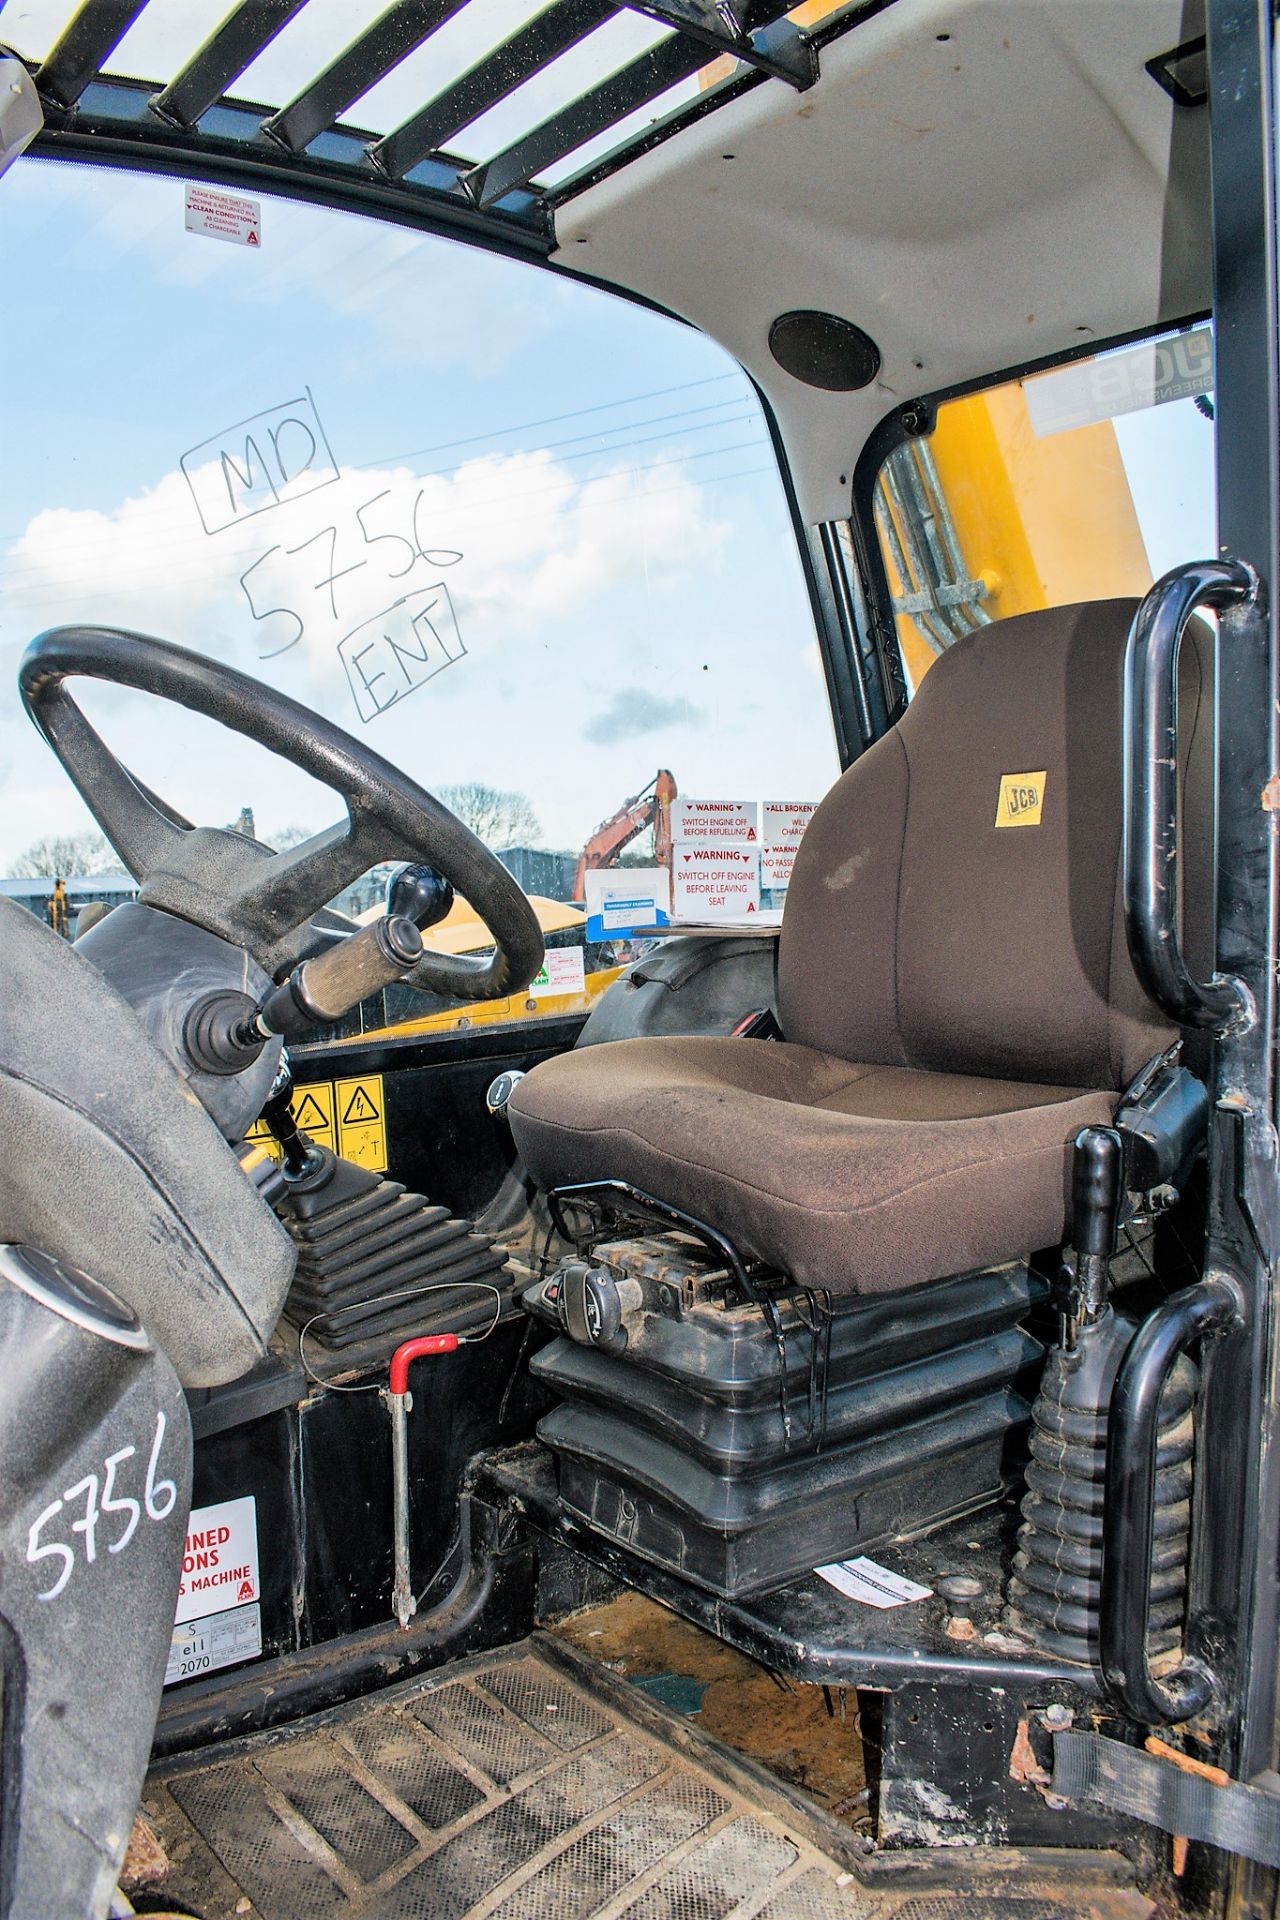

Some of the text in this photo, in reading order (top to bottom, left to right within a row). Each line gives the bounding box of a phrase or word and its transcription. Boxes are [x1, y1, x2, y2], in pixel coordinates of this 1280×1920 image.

[209, 194, 228, 203] ENSURE
[189, 197, 213, 206] MACHINE
[219, 204, 244, 214] RETURNED
[193, 204, 252, 223] CLEAN CONDITION
[213, 217, 239, 228] CLEANING
[209, 223, 241, 236] CHARGEABLE
[221, 418, 316, 513] MD
[240, 489, 464, 660] 5756
[1009, 787, 1036, 813] JCB
[695, 804, 734, 812] WARNING
[770, 804, 784, 812] ALL
[681, 818, 747, 826] SWITCH ENGINE OFF
[683, 828, 746, 836] BEFORE REFUELLING
[781, 828, 804, 836] CHARG
[693, 850, 741, 860] WARNING
[762, 859, 774, 867] NO
[677, 871, 755, 880] SWITCH OFF ENGINE
[772, 870, 791, 879] ALLO
[686, 884, 748, 893] BEFORE LEAVING
[708, 896, 726, 906] SEAT
[25, 1410, 178, 1601] 5756
[185, 1526, 231, 1553] INED
[182, 1549, 220, 1574] ONS
[191, 1565, 251, 1593] MACHINE
[188, 1623, 196, 1636] S
[180, 1655, 210, 1676] 2070
